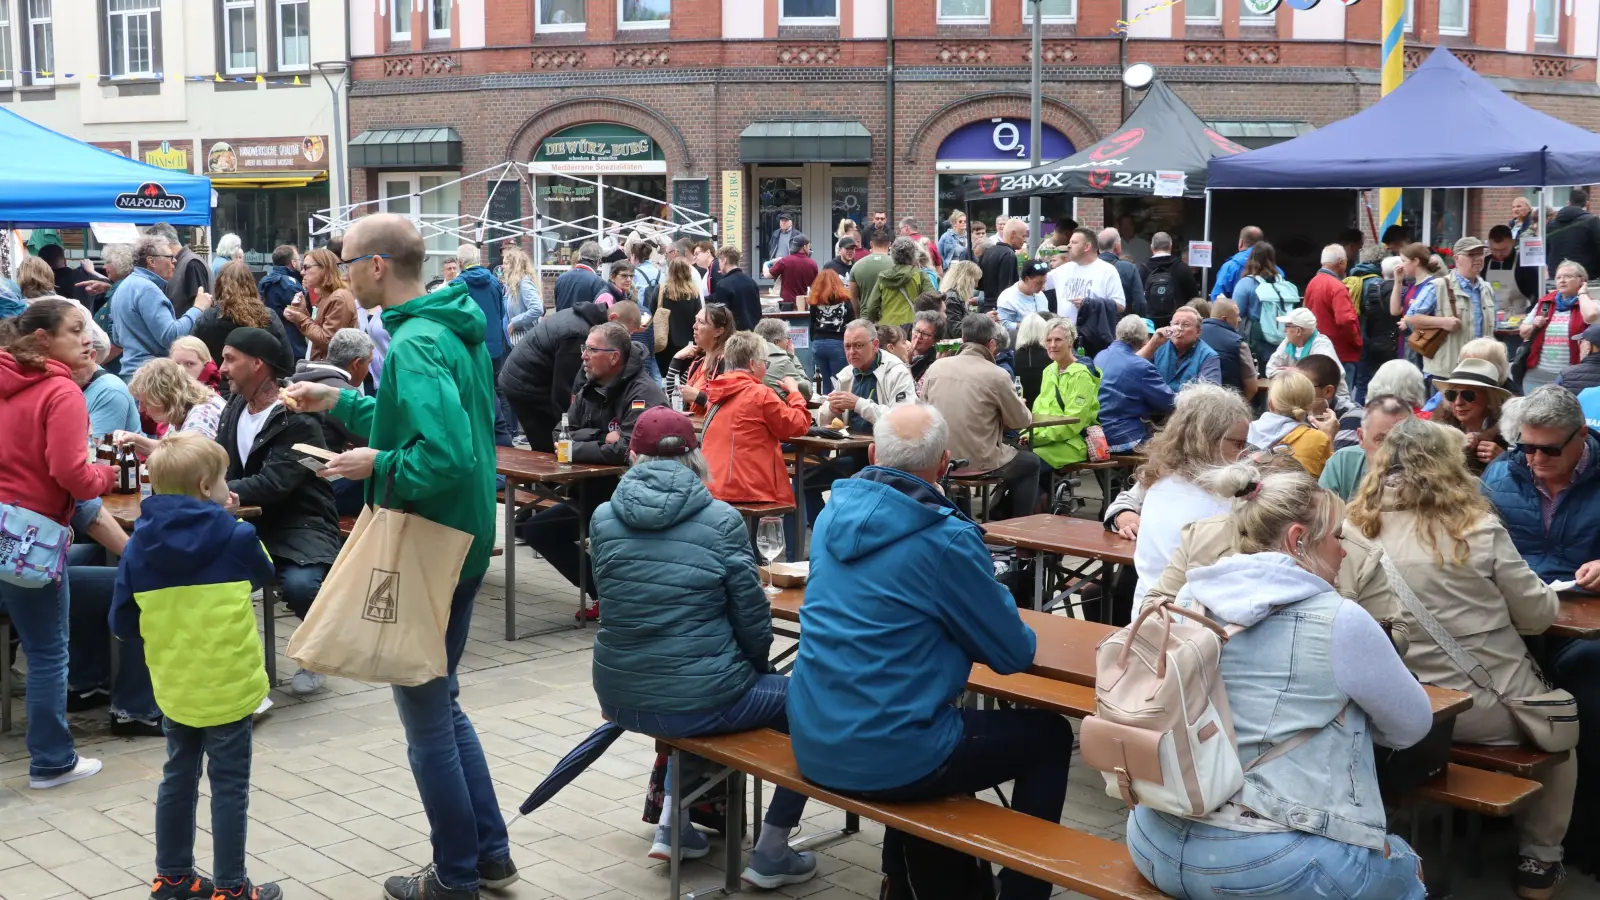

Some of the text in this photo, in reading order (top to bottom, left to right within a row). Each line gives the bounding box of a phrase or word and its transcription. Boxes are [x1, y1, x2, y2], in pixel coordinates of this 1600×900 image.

[993, 122, 1025, 157] O2
[545, 142, 565, 155] DIE
[1000, 172, 1064, 191] 24MX
[119, 197, 181, 209] NAPOLEON
[1010, 213, 1045, 222] yourfe
[369, 607, 391, 618] ALI
